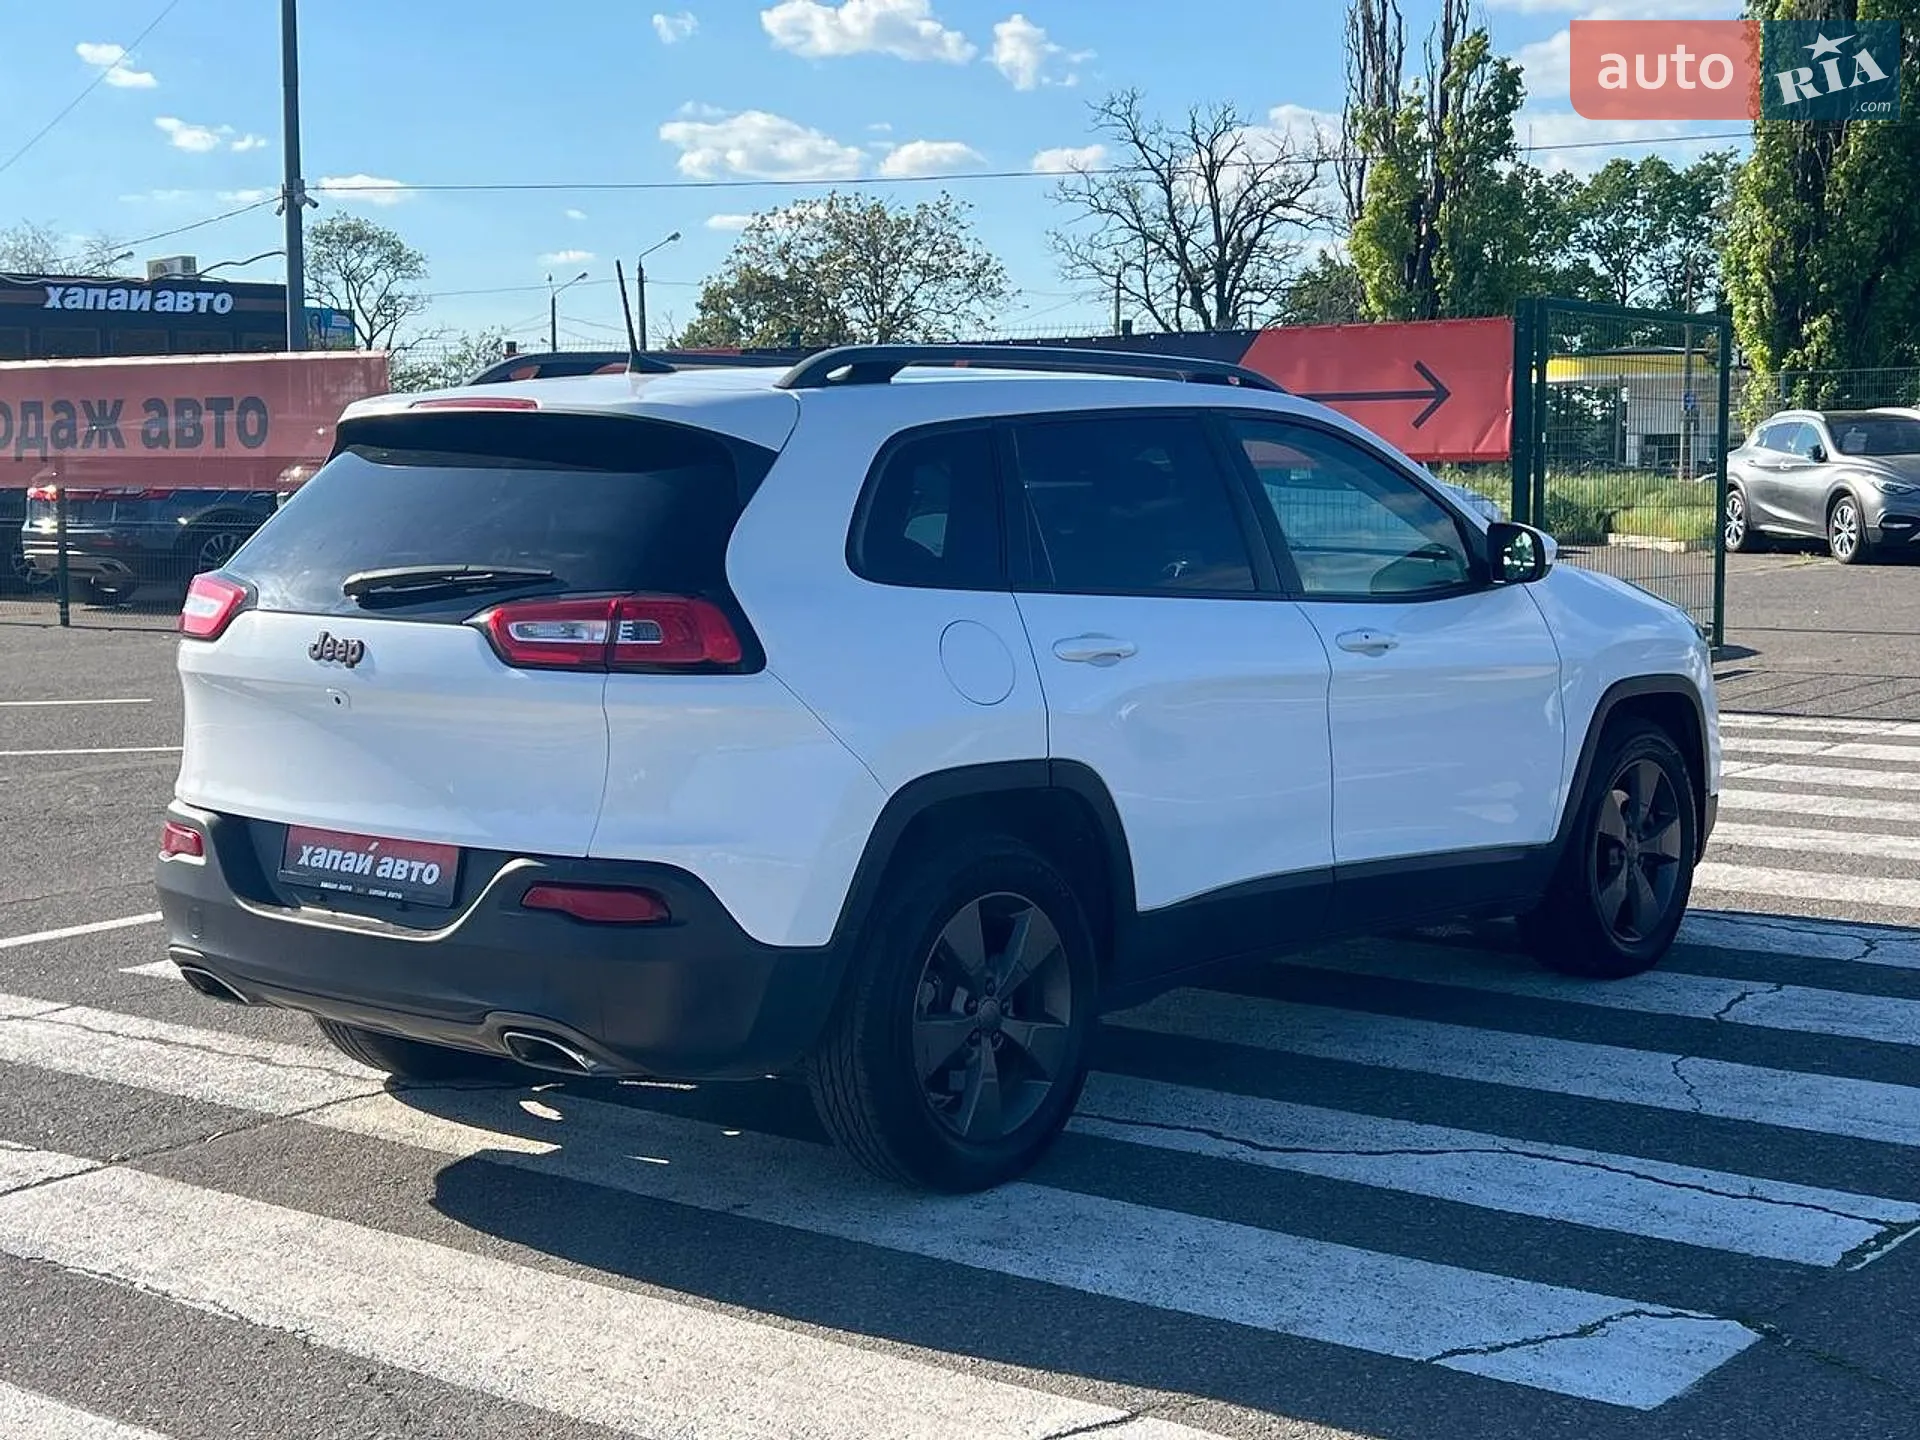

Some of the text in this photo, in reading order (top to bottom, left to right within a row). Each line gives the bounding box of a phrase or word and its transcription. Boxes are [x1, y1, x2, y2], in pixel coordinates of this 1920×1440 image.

[154, 289, 234, 315] авто
[141, 396, 268, 450] авто
[308, 631, 364, 668] Jeep
[297, 841, 440, 885] хапай авто
